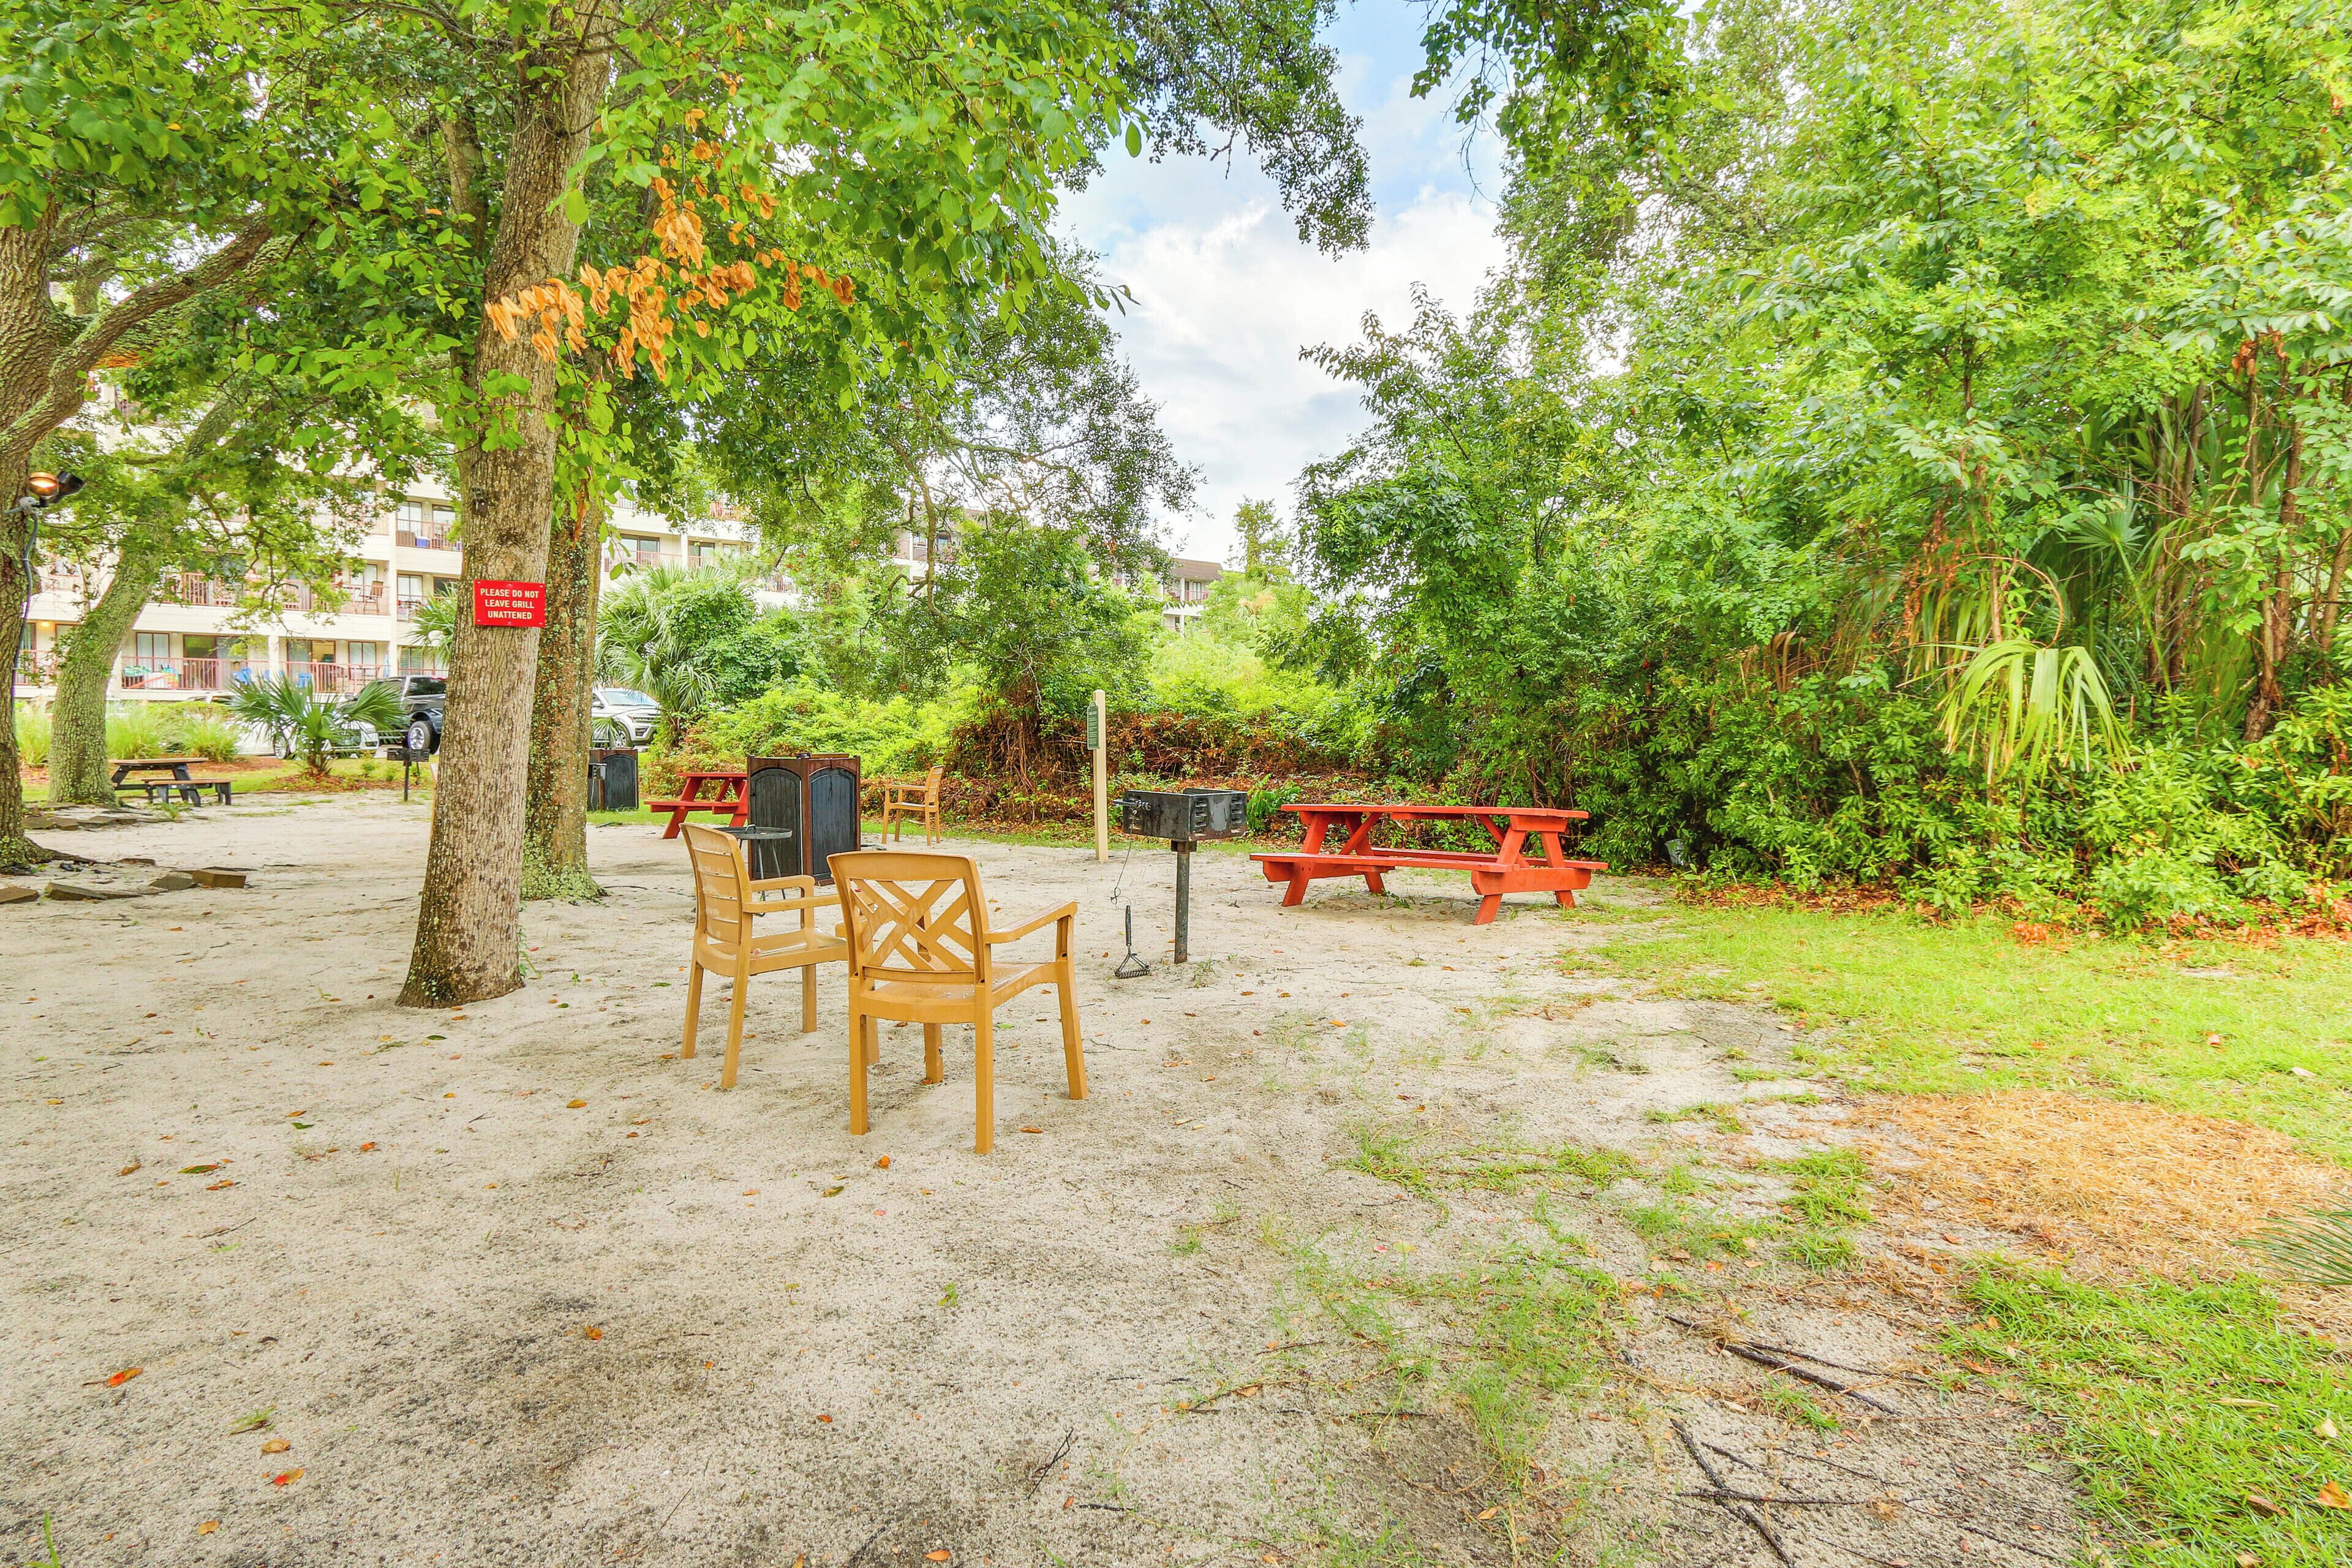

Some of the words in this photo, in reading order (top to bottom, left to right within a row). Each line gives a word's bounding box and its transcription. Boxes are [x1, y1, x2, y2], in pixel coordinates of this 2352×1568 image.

[480, 588, 510, 597] PLEASE
[512, 589, 522, 598] DO
[484, 599, 510, 608] LEAVE
[512, 600, 535, 609] GRILL
[488, 610, 532, 619] UNATTENED
